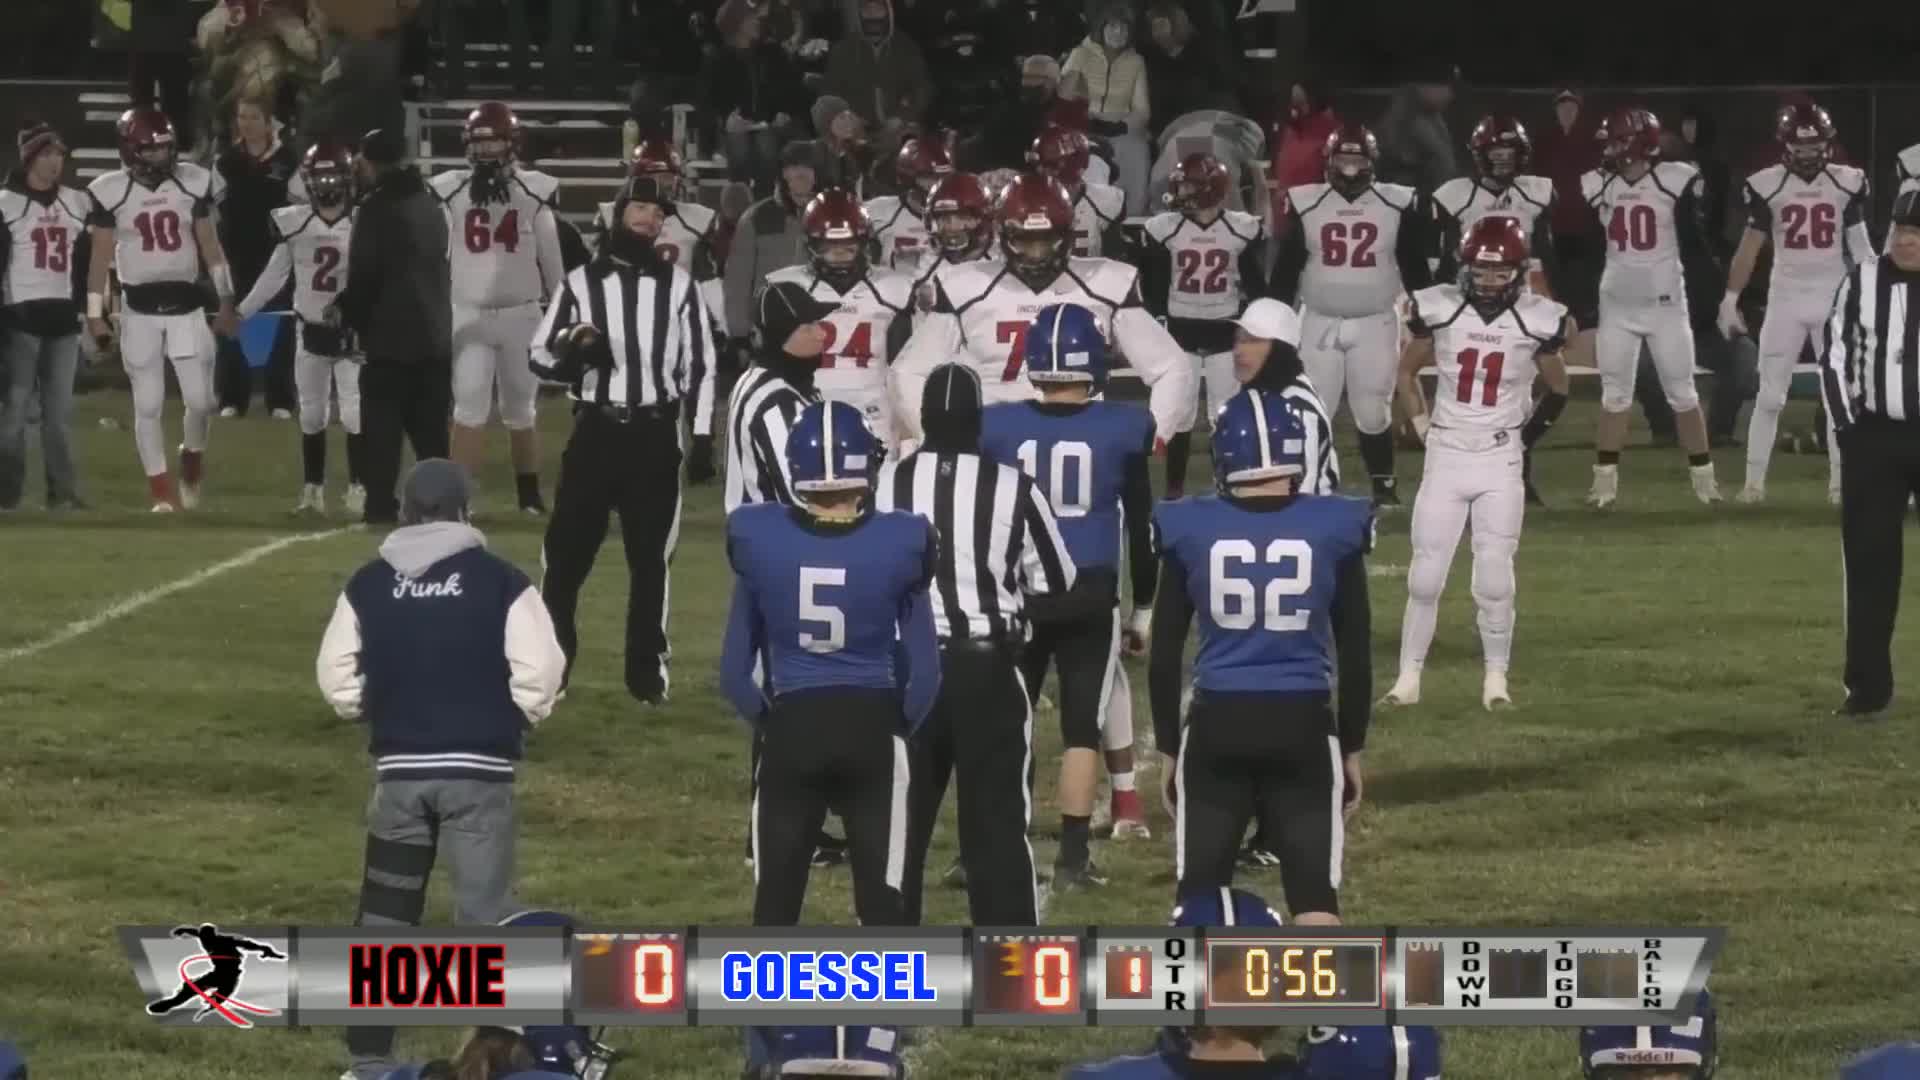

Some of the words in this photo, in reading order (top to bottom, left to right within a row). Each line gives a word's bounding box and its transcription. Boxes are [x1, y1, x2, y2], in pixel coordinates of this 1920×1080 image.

[134, 210, 181, 251] 10
[465, 208, 519, 253] 64
[1321, 222, 1378, 268] 62
[1608, 205, 1656, 251] 40
[1781, 203, 1835, 249] 26
[31, 227, 68, 272] 13
[312, 247, 340, 291] 2
[1178, 249, 1230, 293] 22
[816, 321, 873, 368] 24
[1457, 347, 1504, 406] 11
[1017, 439, 1092, 517] 10
[393, 571, 463, 598] Funk
[1209, 539, 1312, 631] 62
[800, 567, 846, 652] 5
